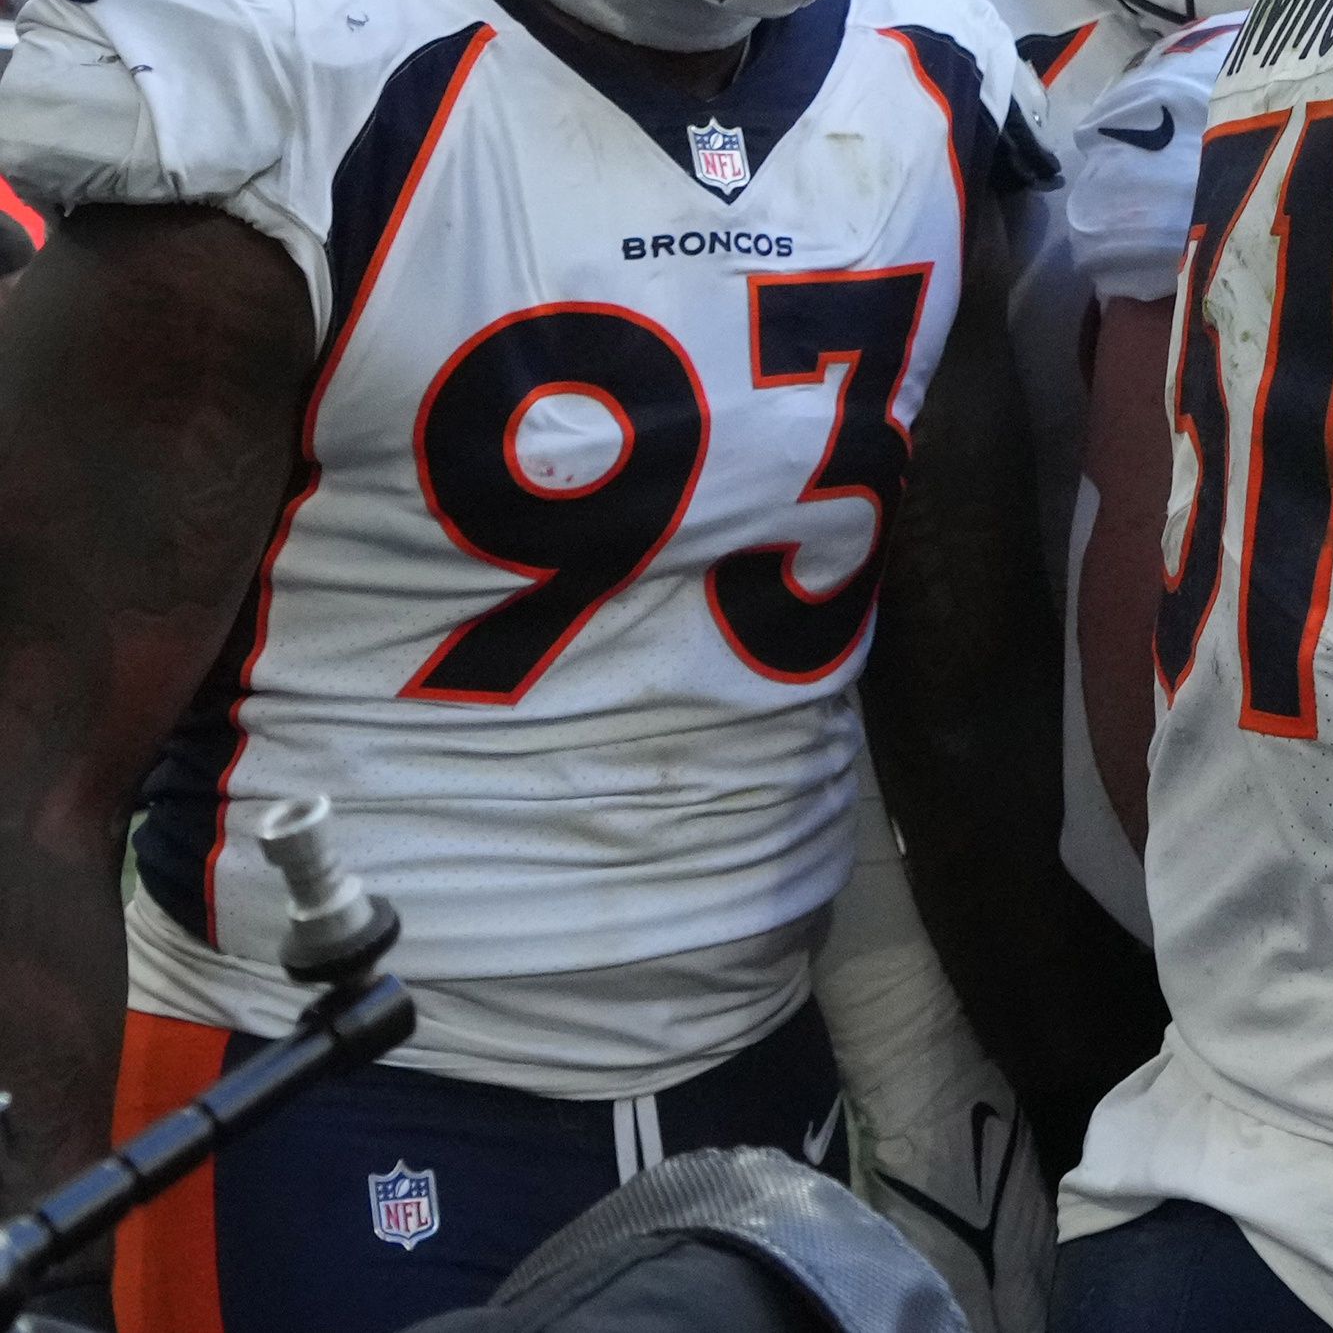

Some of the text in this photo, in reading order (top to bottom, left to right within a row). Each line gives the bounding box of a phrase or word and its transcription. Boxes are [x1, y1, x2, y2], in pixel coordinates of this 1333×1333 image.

[702, 152, 742, 180] NFL
[622, 231, 793, 260] BRONCOS
[396, 262, 936, 706] 93
[384, 1200, 428, 1233] NFL
